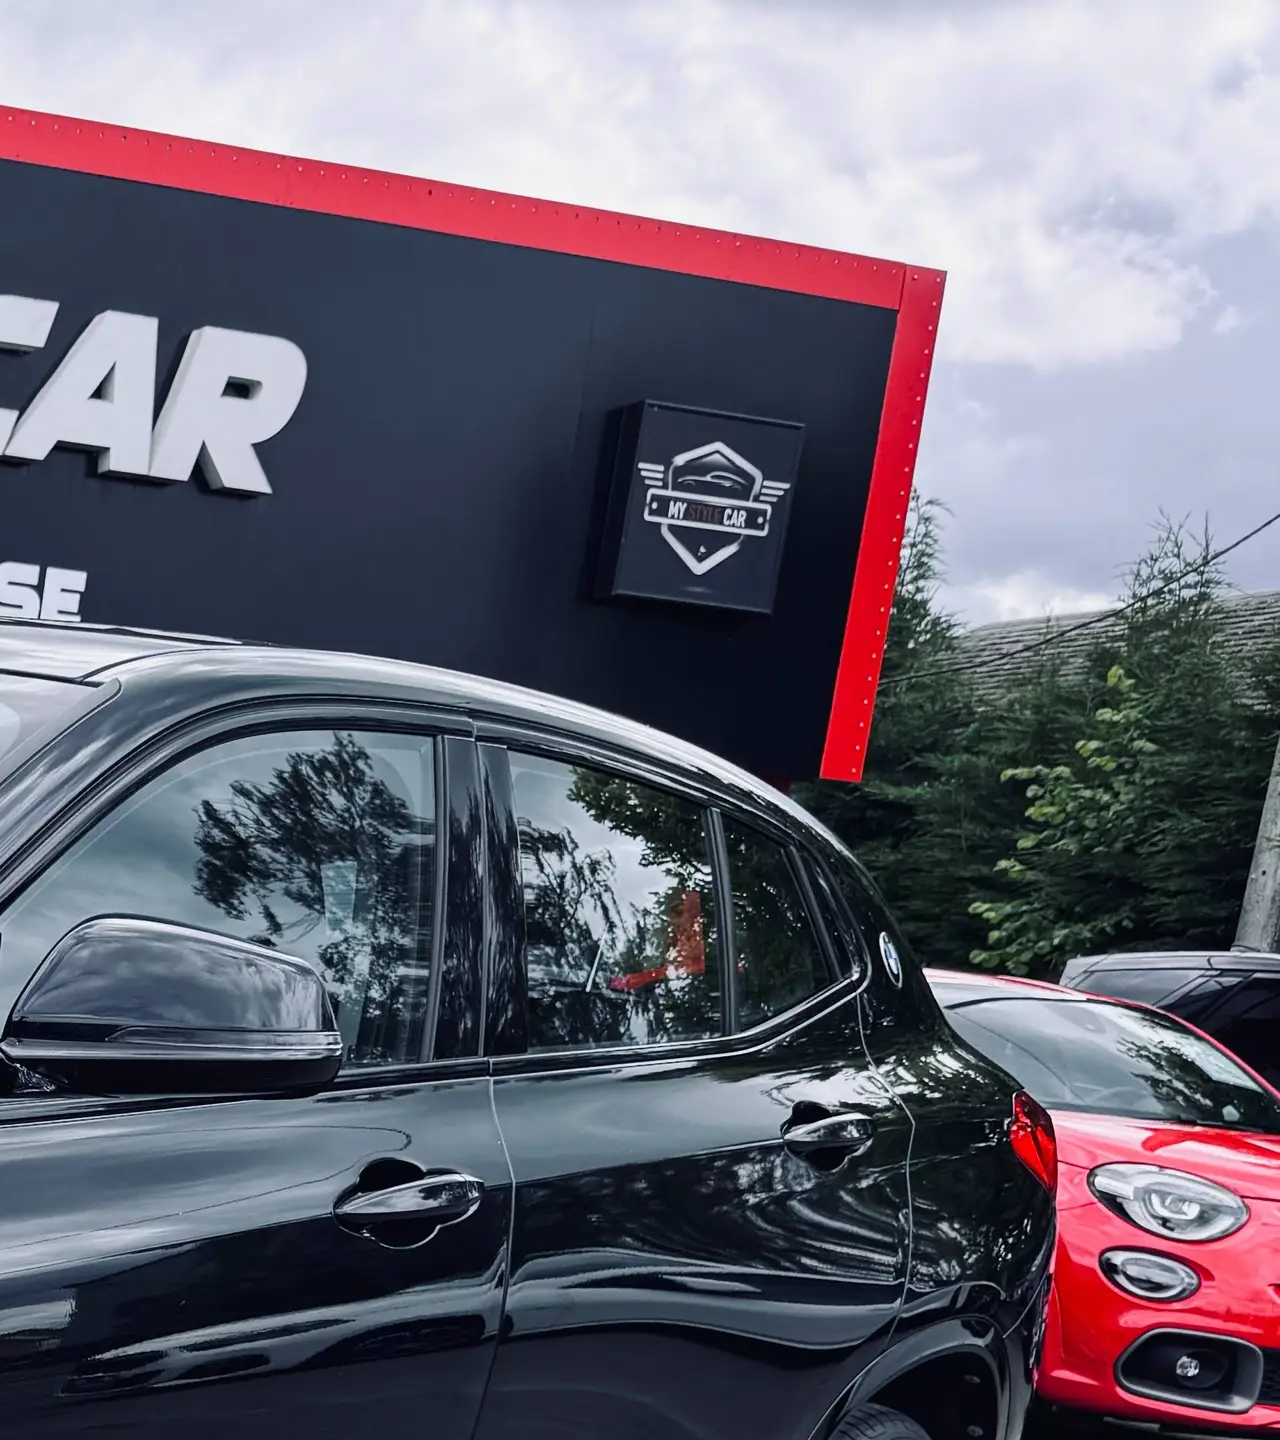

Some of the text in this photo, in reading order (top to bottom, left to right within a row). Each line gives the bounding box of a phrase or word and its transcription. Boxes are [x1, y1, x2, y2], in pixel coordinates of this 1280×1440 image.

[668, 500, 747, 528] MY STYLE CAR
